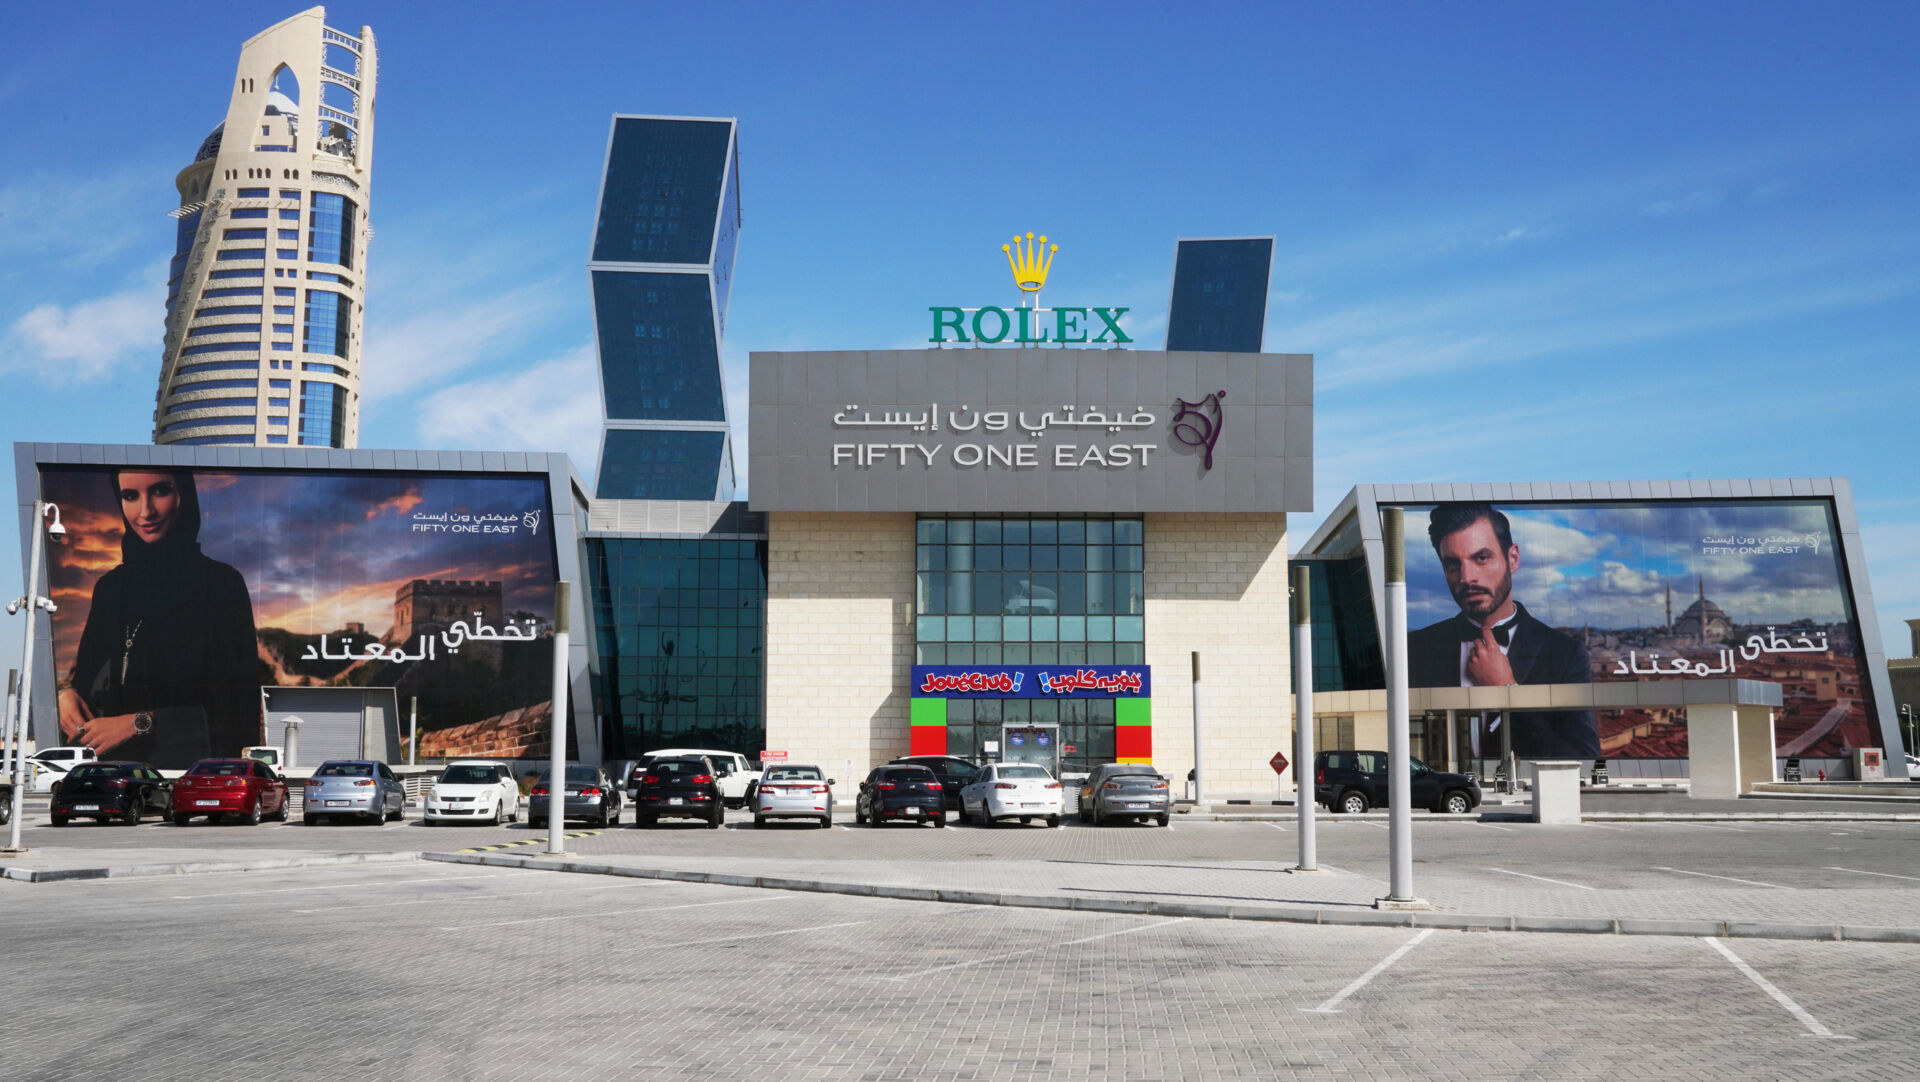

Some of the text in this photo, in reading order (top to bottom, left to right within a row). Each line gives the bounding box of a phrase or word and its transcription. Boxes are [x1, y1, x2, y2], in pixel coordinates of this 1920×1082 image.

[929, 306, 1133, 343] ROLEX
[833, 403, 1156, 437] فيفتي ون إيست
[833, 443, 1158, 467] FIFTY ONE EAST
[412, 523, 518, 534] FIFTY ONE EAST
[450, 513, 470, 522] ون
[1702, 546, 1801, 555] FIFTY ONE EAST
[300, 634, 436, 664] المعتاد
[1613, 649, 1736, 677] المعتاد
